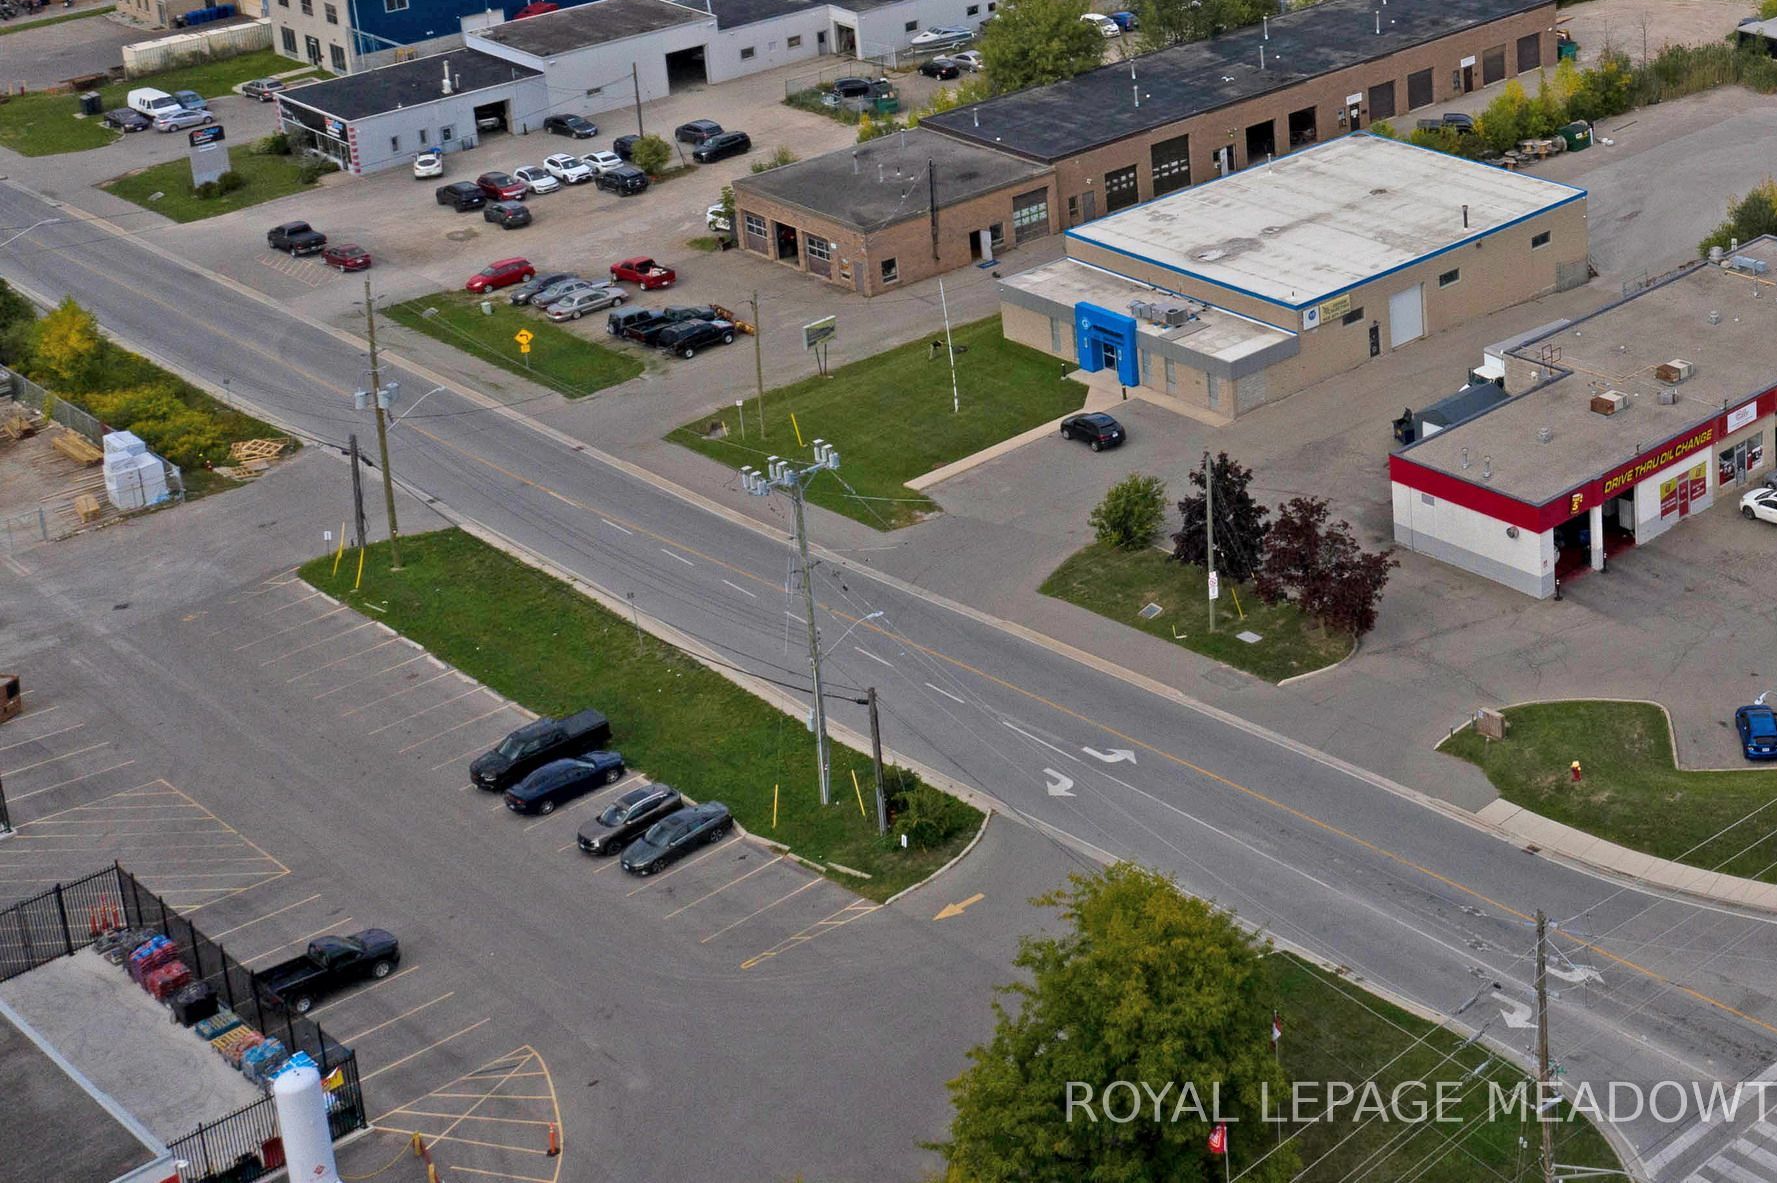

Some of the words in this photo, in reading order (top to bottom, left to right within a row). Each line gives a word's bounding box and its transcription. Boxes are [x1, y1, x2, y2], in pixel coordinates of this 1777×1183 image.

[1604, 469, 1633, 494] DRIVE
[1634, 455, 1661, 478] THRU
[1660, 450, 1674, 466] OIL
[1675, 428, 1713, 458] CHANGE
